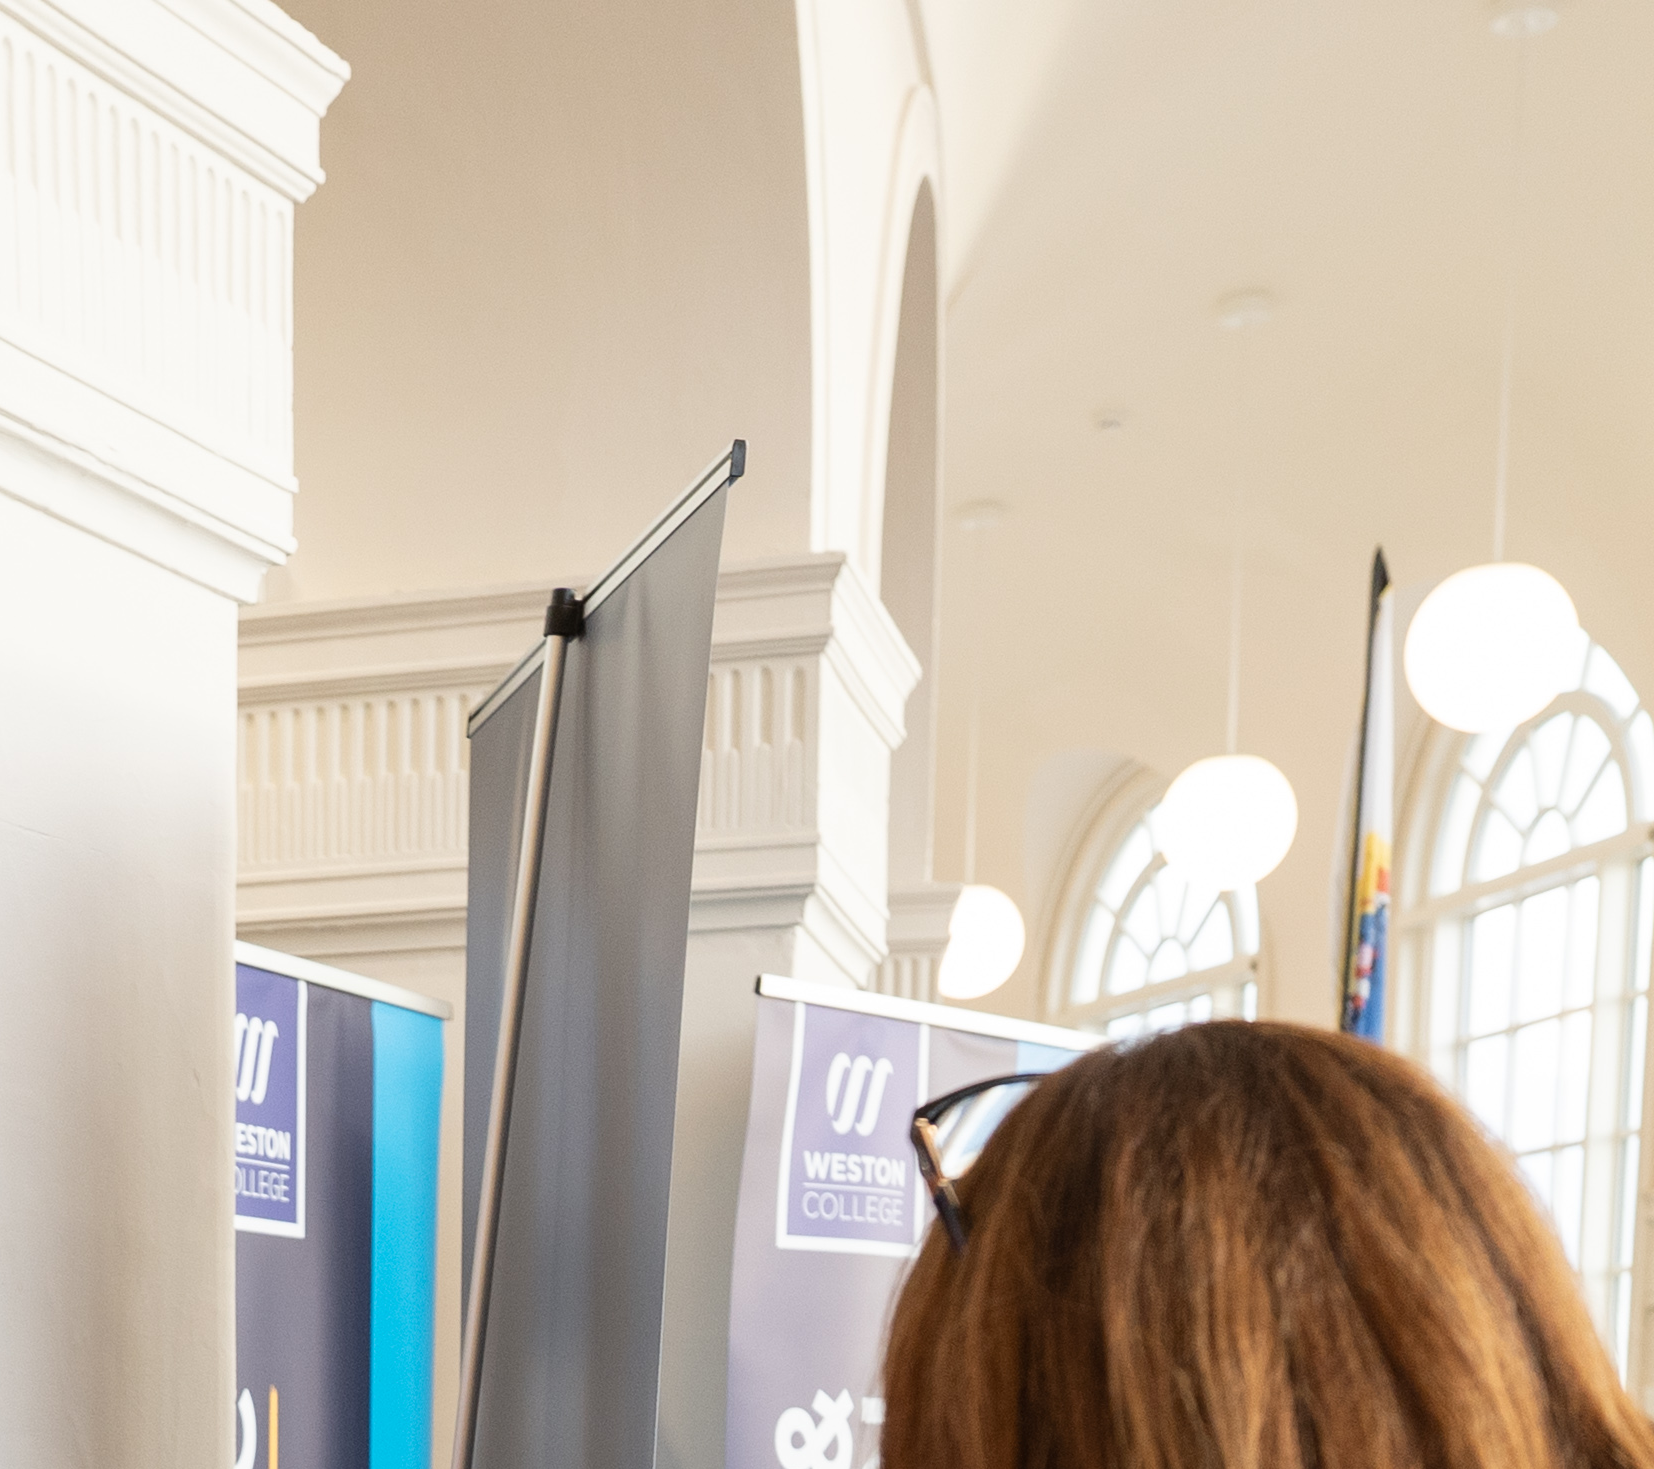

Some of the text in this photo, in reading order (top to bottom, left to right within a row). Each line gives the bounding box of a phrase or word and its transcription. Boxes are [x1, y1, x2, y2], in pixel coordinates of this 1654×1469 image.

[235, 1122, 290, 1161] ESTON
[235, 1164, 290, 1202] OLLEGE
[803, 1150, 905, 1187] WESTON
[802, 1190, 903, 1226] COLLEGE
